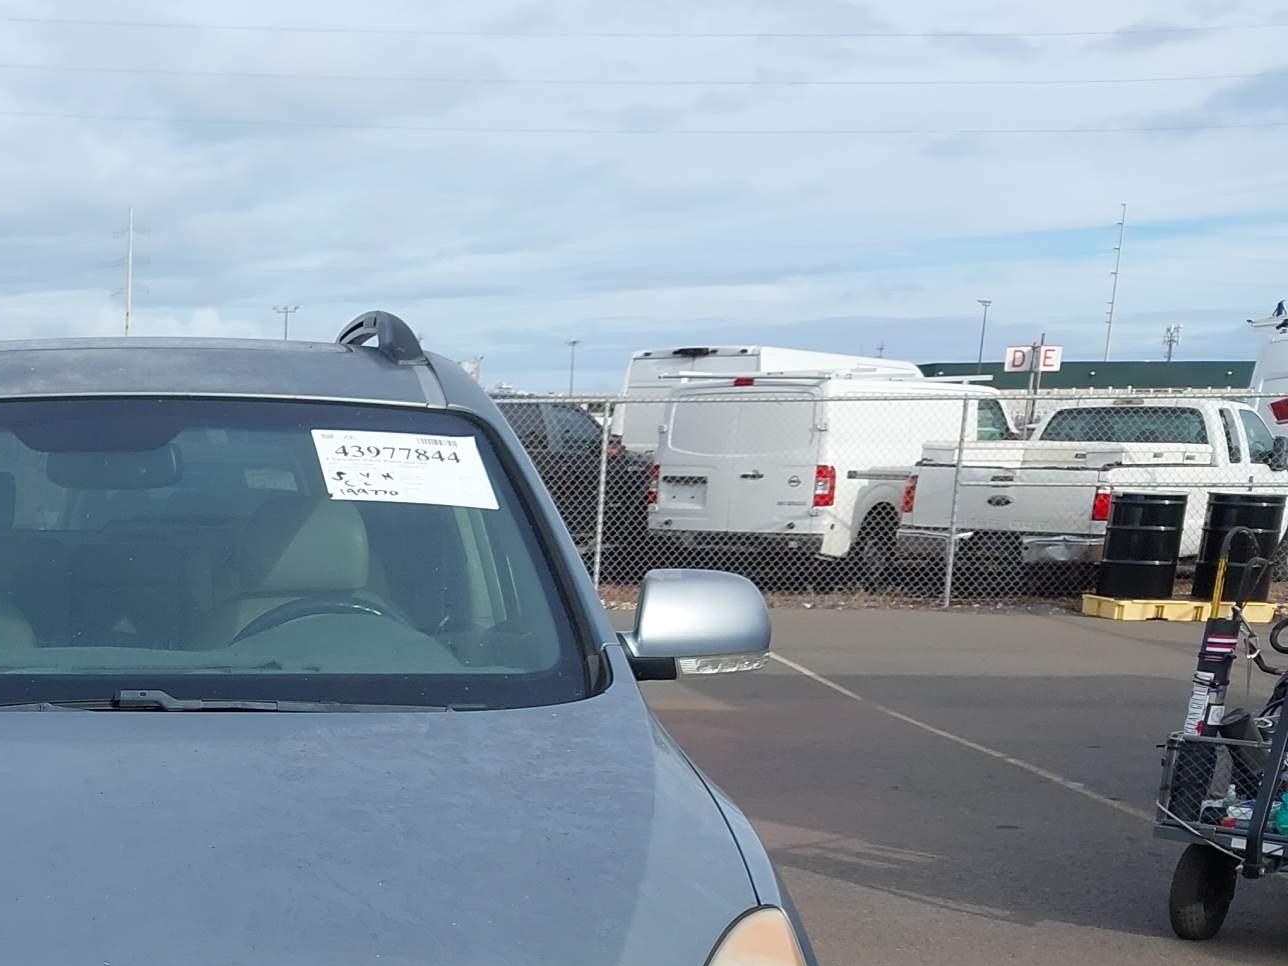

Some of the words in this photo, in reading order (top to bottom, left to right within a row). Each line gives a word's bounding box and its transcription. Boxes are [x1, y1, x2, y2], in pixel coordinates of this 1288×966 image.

[1013, 350, 1026, 368] D
[1043, 350, 1056, 367] E
[335, 444, 461, 463] 43977844
